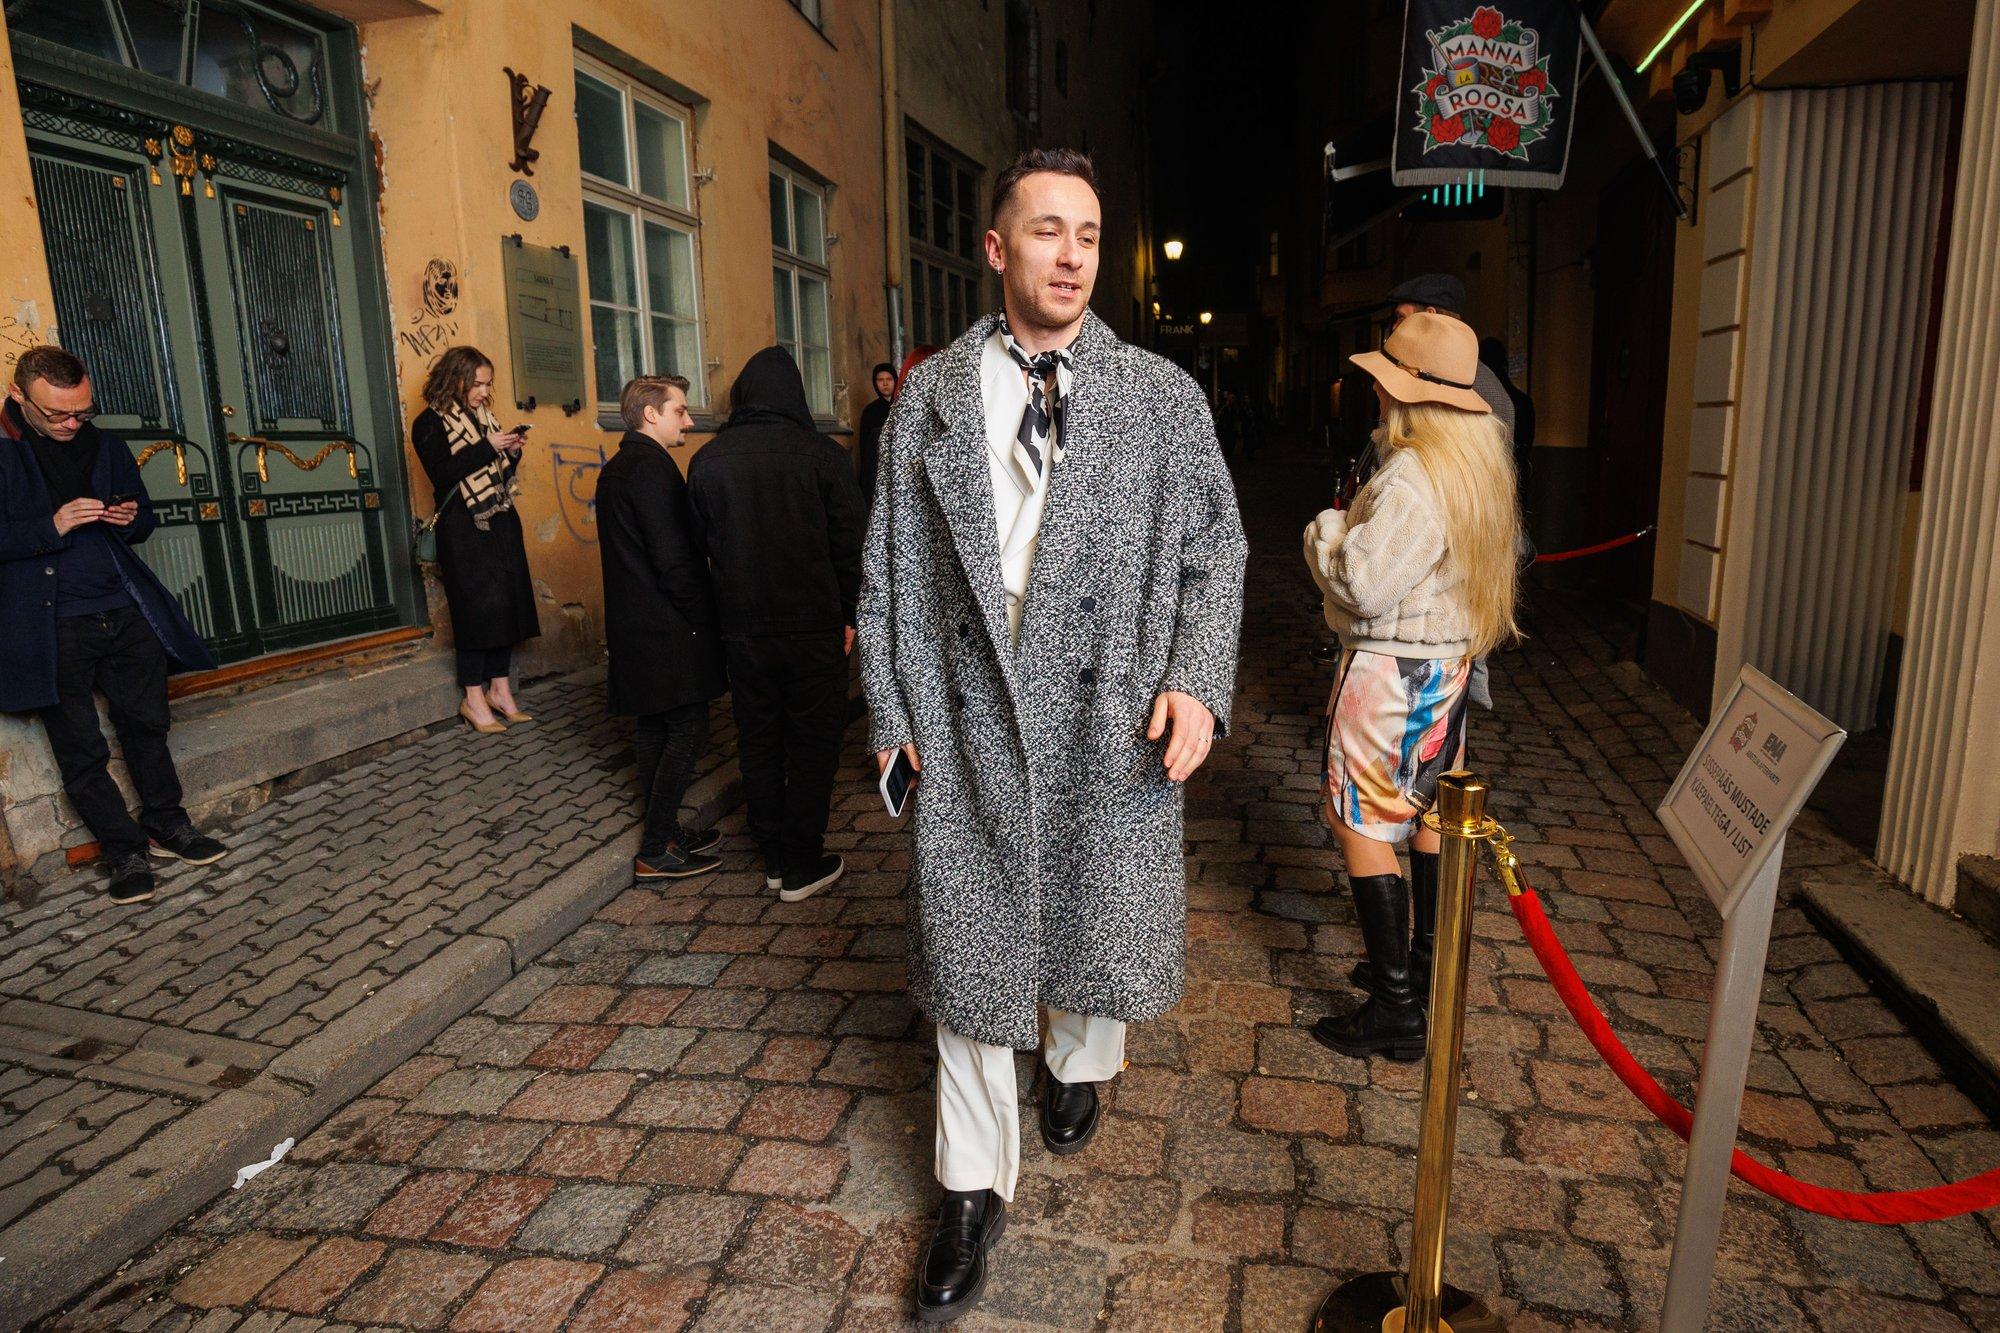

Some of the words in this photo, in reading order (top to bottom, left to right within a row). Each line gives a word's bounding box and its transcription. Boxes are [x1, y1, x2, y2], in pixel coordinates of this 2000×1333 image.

[1446, 40, 1523, 67] MANNA
[1459, 74, 1471, 84] LA
[1449, 89, 1527, 119] ROOSA
[1160, 325, 1194, 335] FRANK
[1702, 754, 1734, 795] SISSEPÄÄS
[1729, 786, 1771, 835] MUSTADE
[1689, 776, 1731, 835] KÄEPAELTEGA
[1732, 831, 1753, 859] LIST
